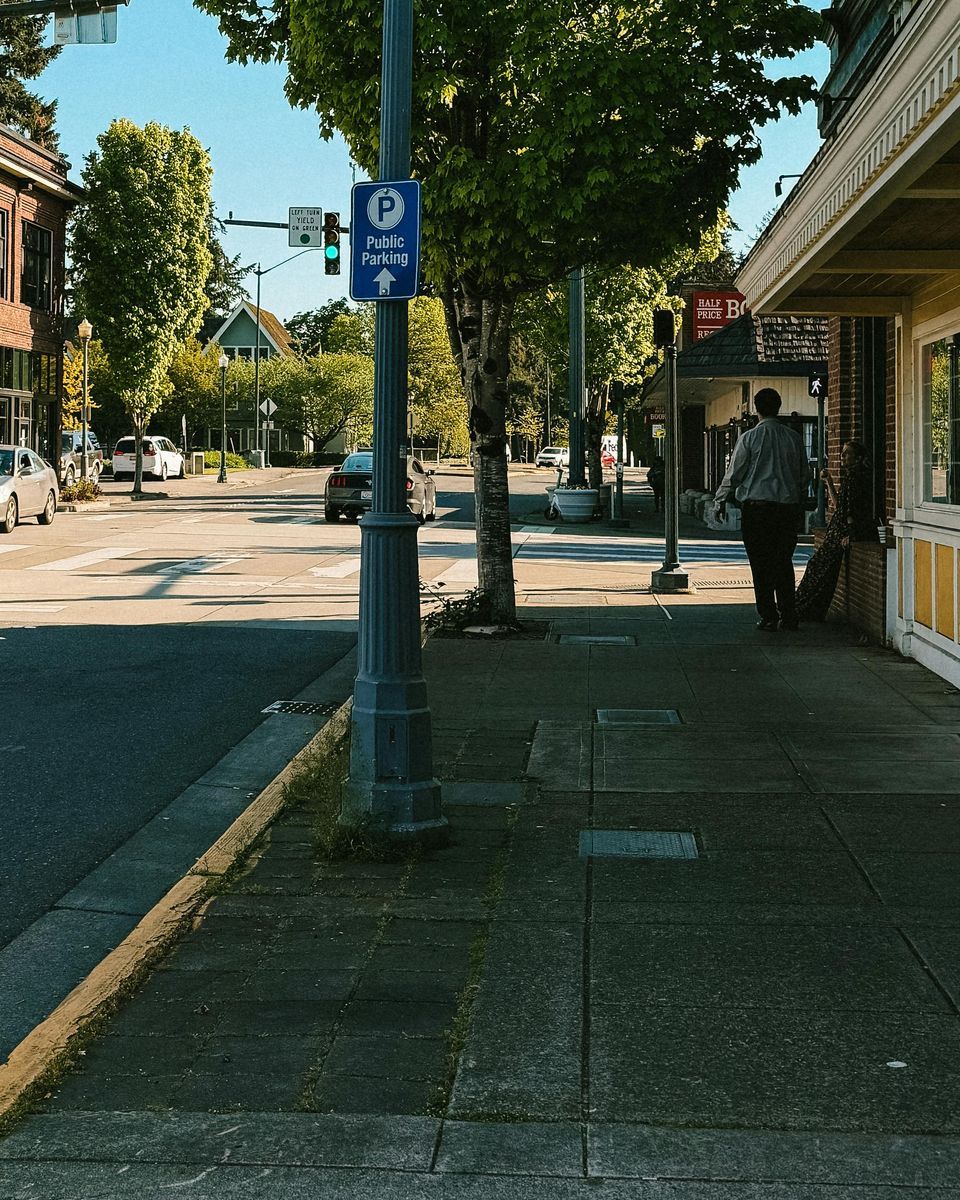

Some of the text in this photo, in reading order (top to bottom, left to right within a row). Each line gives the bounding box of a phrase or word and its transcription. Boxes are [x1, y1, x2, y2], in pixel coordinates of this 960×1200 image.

[378, 196, 396, 222] P
[296, 216, 315, 224] YIELD
[367, 234, 405, 250] Public
[362, 251, 409, 267] Parking
[698, 298, 722, 308] HALF
[697, 310, 723, 320] PRICE
